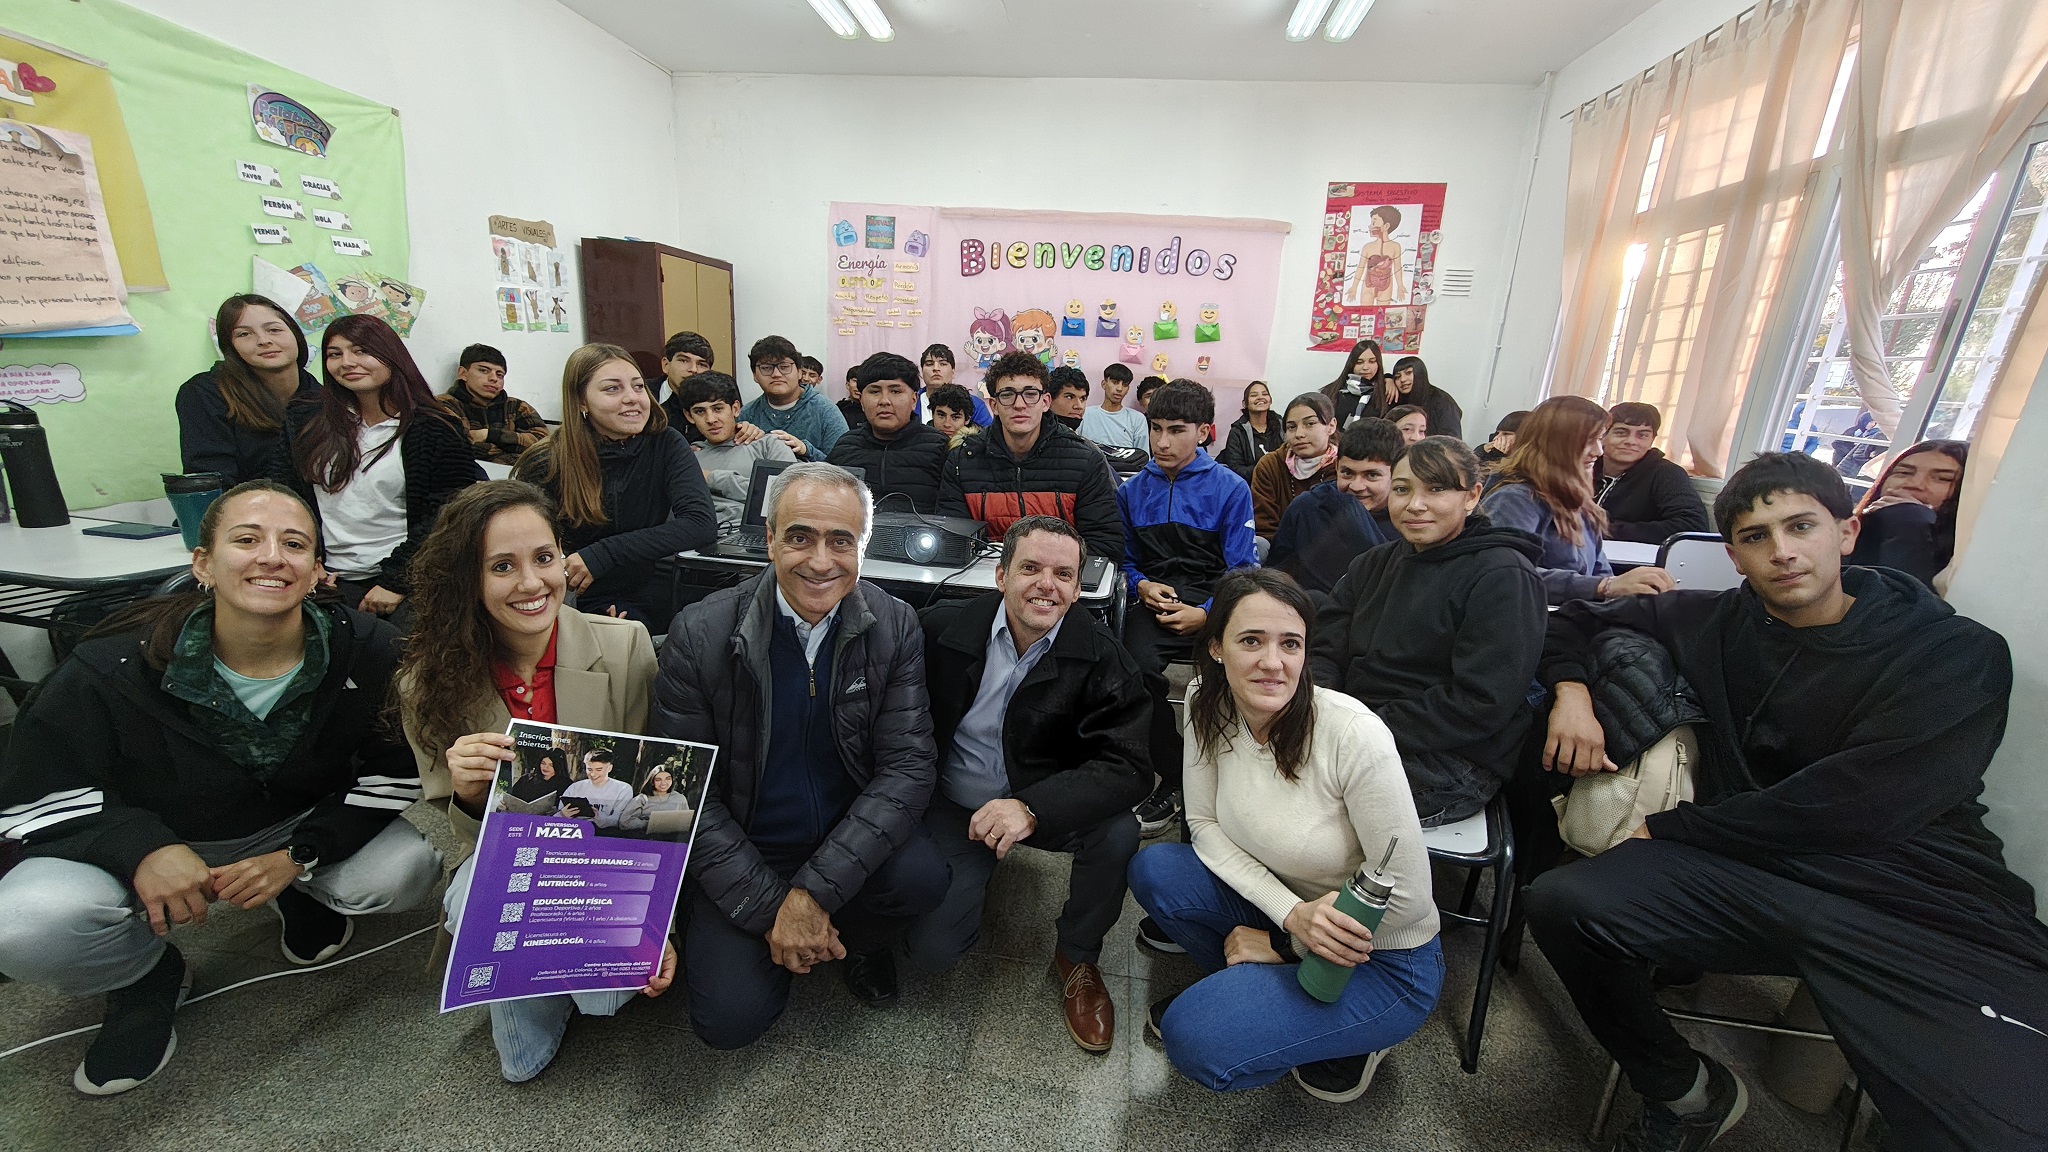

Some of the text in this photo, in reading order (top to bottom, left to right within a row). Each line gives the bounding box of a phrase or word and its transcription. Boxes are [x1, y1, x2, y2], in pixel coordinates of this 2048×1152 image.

[258, 99, 326, 132] Palabras
[41, 165, 57, 173] por
[243, 163, 257, 172] POR
[241, 172, 262, 181] FAVOR
[302, 180, 331, 192] GRACIAS
[3, 200, 39, 213] cantidad
[41, 205, 53, 214] de
[263, 199, 293, 211] PERDÓN
[314, 215, 332, 224] HOLA
[10, 231, 25, 242] que
[253, 228, 280, 236] PERMISO
[333, 240, 361, 249] DE NADA
[960, 236, 1238, 281] Bienvenidos
[837, 254, 888, 277] Energía
[838, 275, 886, 289] amor
[519, 731, 571, 745] Inscripciones
[517, 740, 552, 751] abiertas
[535, 827, 583, 839] MAZA
[543, 857, 589, 865] RECURSOS
[590, 858, 634, 866] HUMANOS
[537, 879, 586, 887] NUTRICIÓN
[532, 897, 613, 906] EDUCACIÓN FÍSICA
[522, 936, 584, 947] KINESIOLOGÍA
